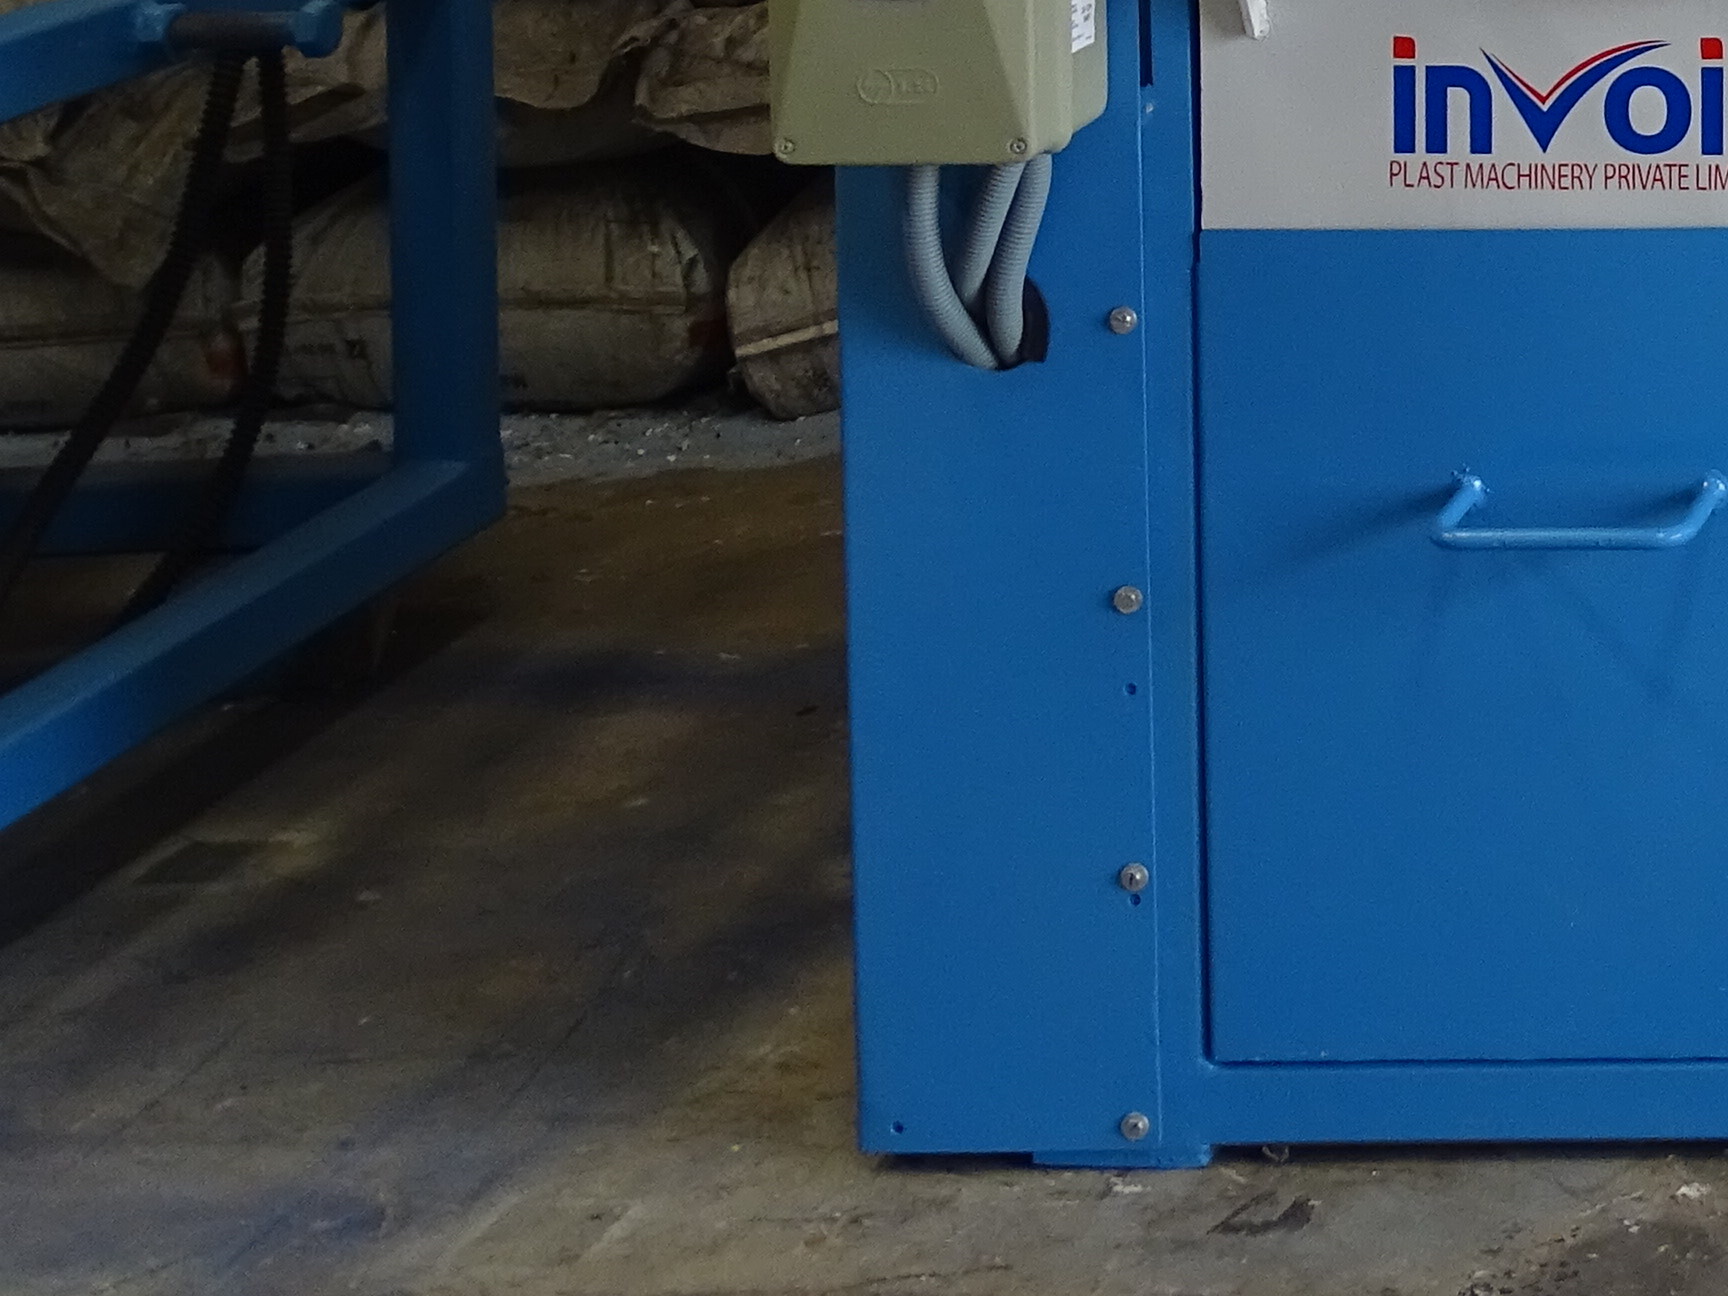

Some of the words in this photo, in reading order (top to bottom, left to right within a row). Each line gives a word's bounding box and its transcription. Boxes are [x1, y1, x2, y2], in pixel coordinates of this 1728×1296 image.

[1389, 160, 1459, 189] PLAST
[1464, 162, 1598, 190] MACHINERY
[1604, 163, 1690, 190] PRIVATE
